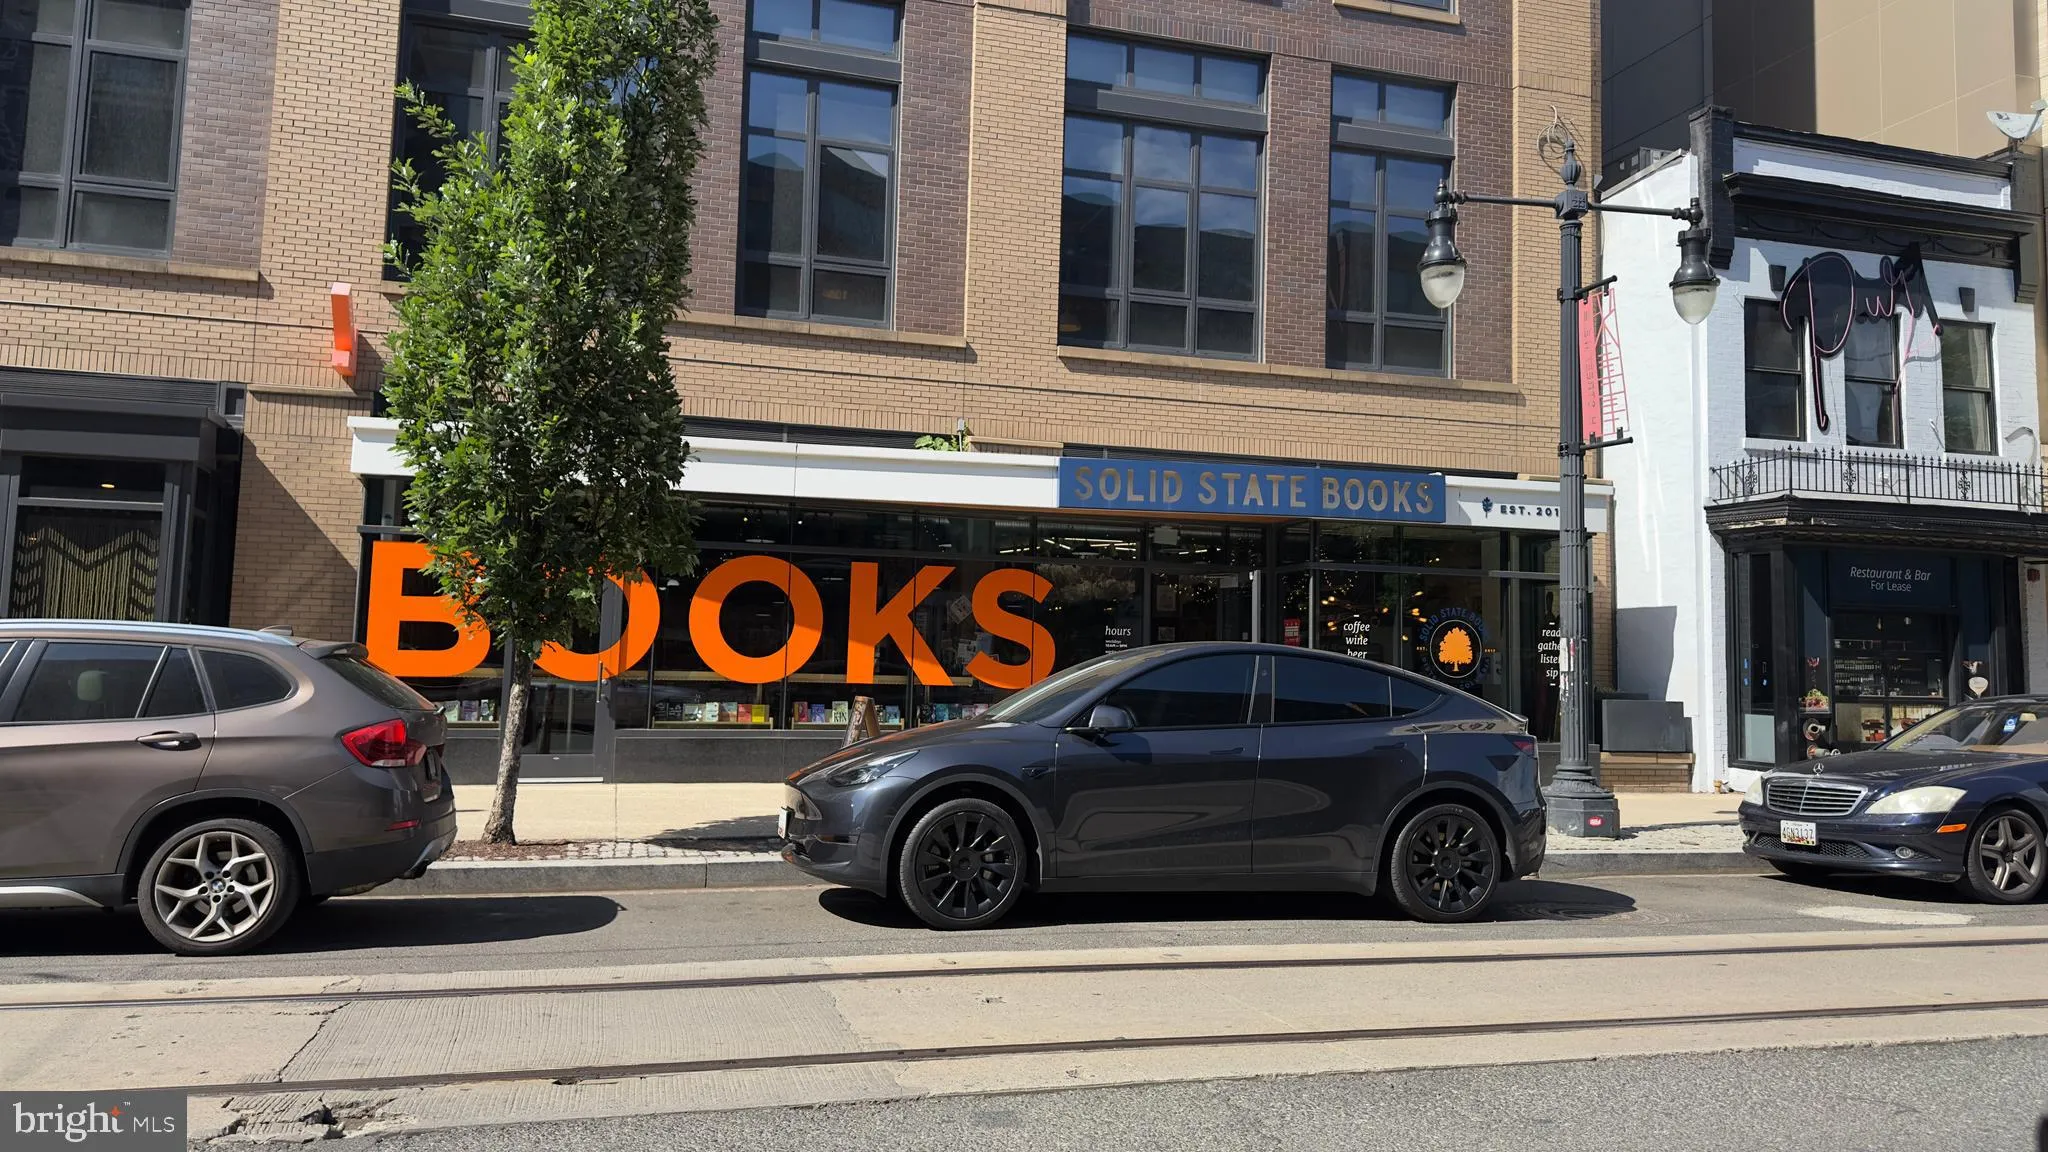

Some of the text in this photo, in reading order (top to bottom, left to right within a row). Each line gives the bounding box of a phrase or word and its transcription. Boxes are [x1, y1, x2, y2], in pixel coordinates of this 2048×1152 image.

[1075, 466, 1434, 514] SOLID STATE BOOKS
[1500, 505, 1561, 517] EST. 201
[1850, 566, 1931, 581] Restaurant & Bar
[1870, 580, 1912, 592] For Lease
[365, 541, 1056, 690] BOOKS
[1105, 625, 1131, 636] hours
[1343, 621, 1370, 633] coffee
[1419, 614, 1439, 642] SOLID
[1440, 607, 1467, 618] STATE
[1345, 635, 1368, 645] wine
[1537, 641, 1560, 653] gathe
[1540, 654, 1560, 663] liste
[1546, 667, 1559, 679] sip
